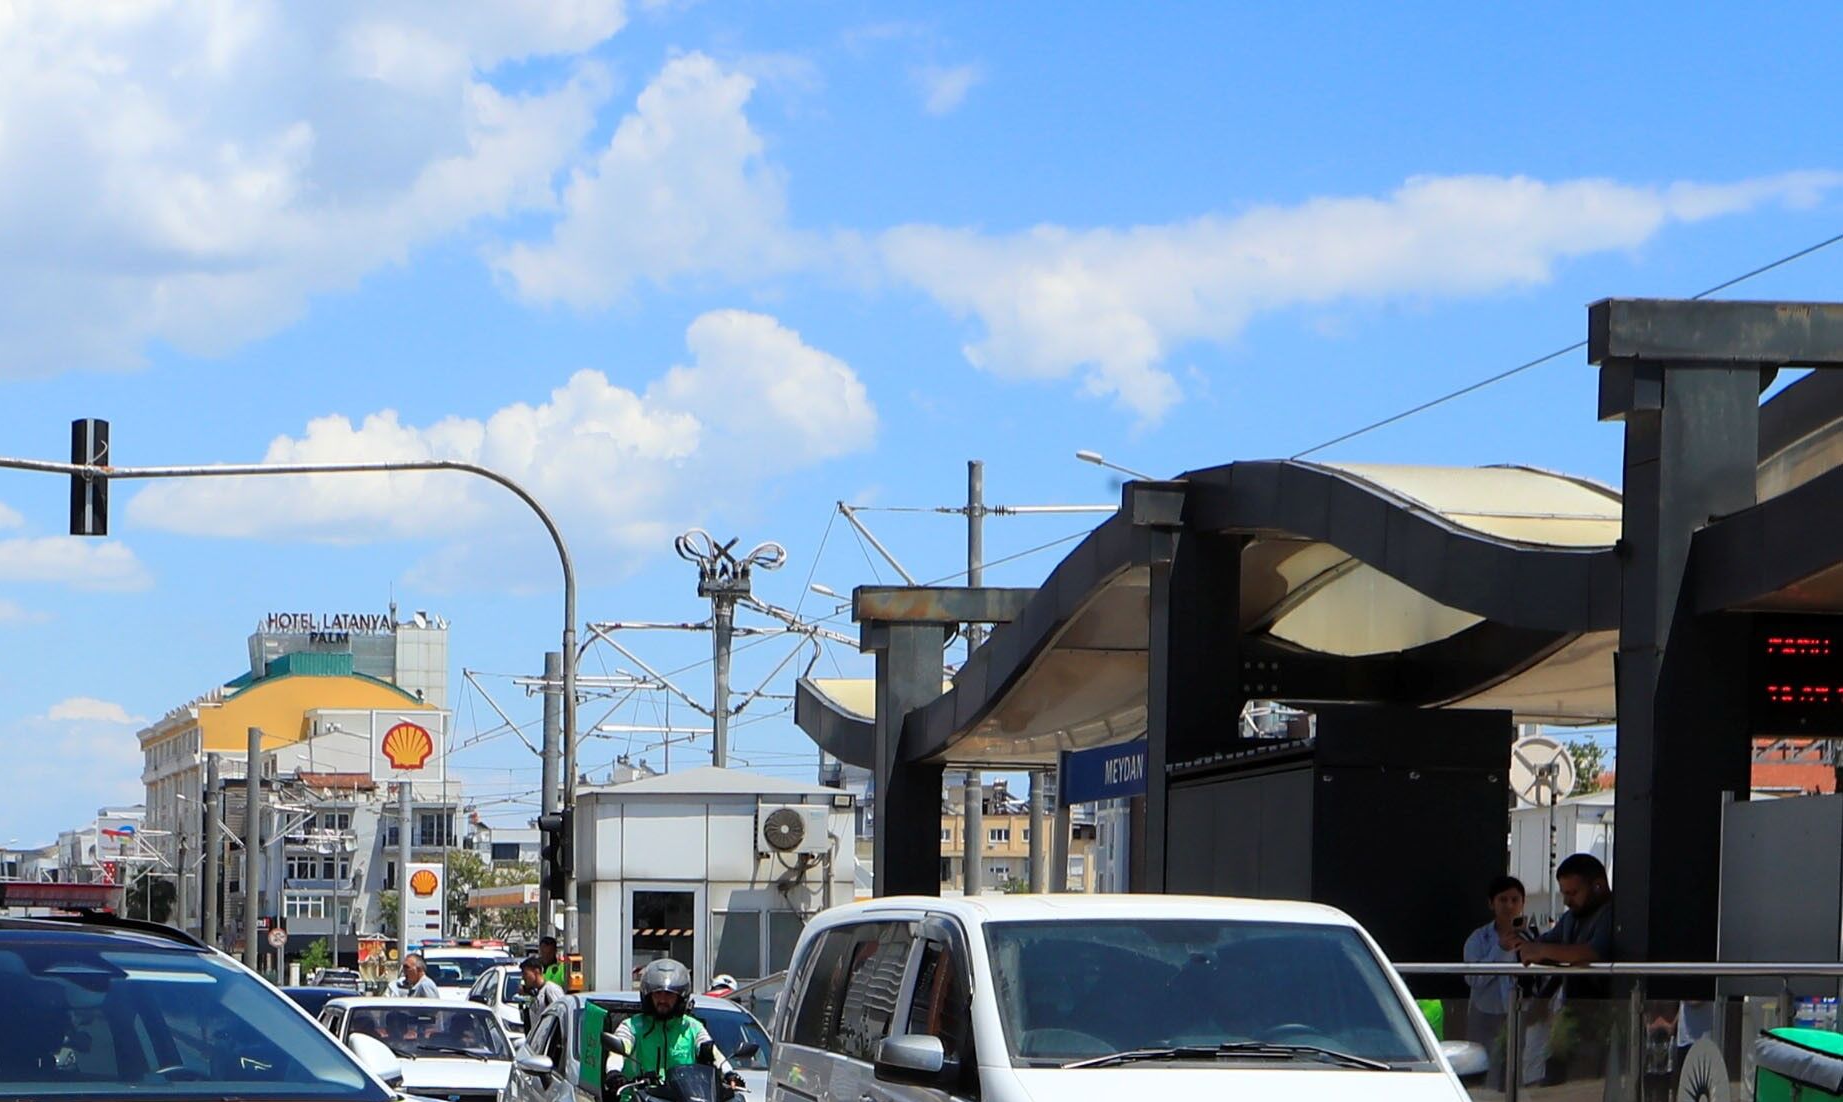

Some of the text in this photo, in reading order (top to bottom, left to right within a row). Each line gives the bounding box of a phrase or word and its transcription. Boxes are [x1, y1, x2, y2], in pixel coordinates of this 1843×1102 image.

[268, 612, 392, 630] HOTEL LATANYA
[309, 632, 349, 644] PALM
[1105, 754, 1144, 785] MEYDAN
